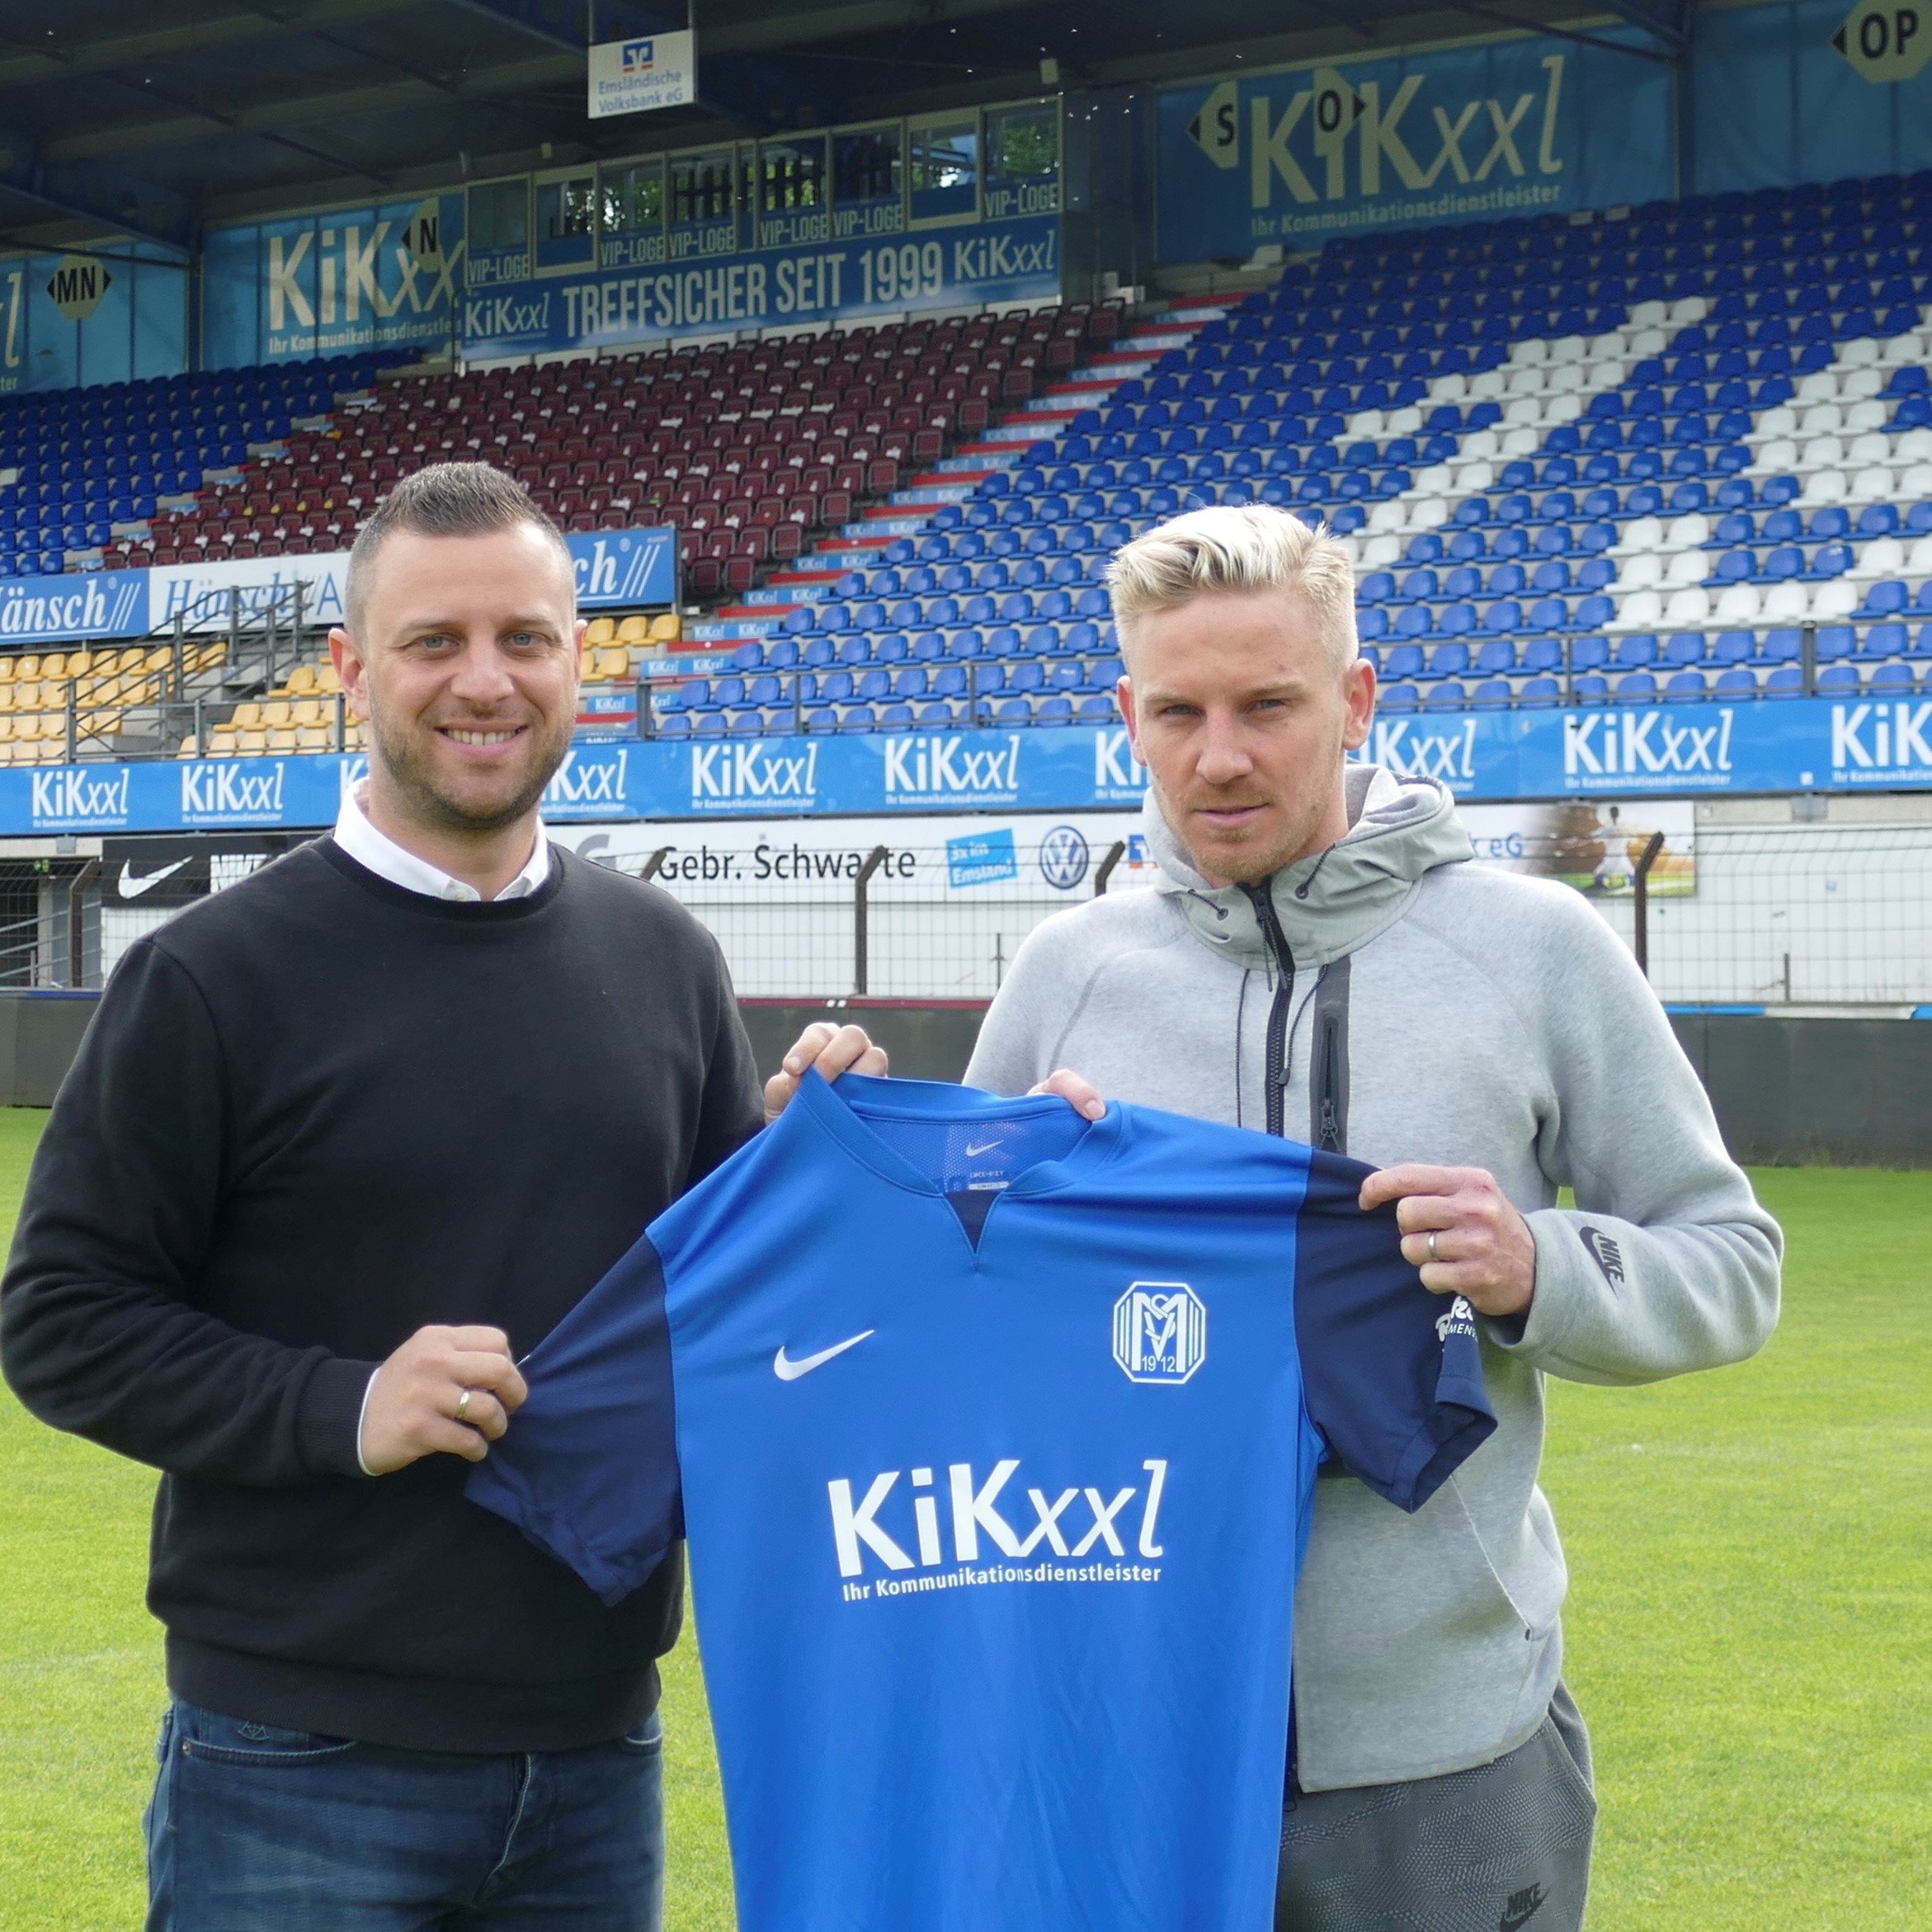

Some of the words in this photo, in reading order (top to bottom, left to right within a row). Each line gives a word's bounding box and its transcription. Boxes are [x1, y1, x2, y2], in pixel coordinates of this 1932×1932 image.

[1860, 8, 1919, 59] OP
[598, 92, 661, 113] Volksbank
[665, 87, 683, 103] eG
[1317, 89, 1342, 133] O
[1217, 102, 1235, 147] S
[832, 205, 904, 237] VIP-LOGE
[985, 184, 1058, 217] VIP-LOGE
[1251, 215, 1276, 238] Ihr
[1280, 183, 1561, 234] Kommunikationsdienstleister
[420, 217, 438, 254] N
[600, 235, 665, 266] VIP-LOGE
[668, 225, 736, 257] VIP-LOGE
[759, 213, 828, 246] VIP-LOGE
[57, 266, 96, 304] MN
[270, 221, 466, 331] KiKxx
[464, 293, 550, 337] KiKxxl
[562, 263, 767, 337] TREFFSICHER
[775, 252, 846, 313] SEIT
[859, 242, 944, 303] 1999
[954, 229, 1055, 280] KiKxxl
[469, 255, 530, 283] VIP-LOGE
[269, 337, 288, 355] Ihr
[0, 577, 106, 633] änsch
[1564, 709, 1733, 774] KiKxxl
[1831, 702, 1932, 768] KiK
[542, 748, 627, 802] Kxxl
[692, 742, 817, 797] KiKxxl
[885, 734, 1020, 791] KiKxxl
[33, 768, 130, 817] KiKxxl
[182, 762, 284, 812] KiKxxl
[659, 846, 741, 880] Gebr.
[754, 843, 917, 880] Schwate
[1491, 832, 1523, 859] eG
[1598, 1235, 1624, 1284] NIKE
[827, 1459, 1167, 1577] KiKxxl
[843, 1583, 870, 1602] Ihr
[876, 1563, 1162, 1597] Kommunikationsdienstleister
[1506, 1881, 1541, 1919] NIKE
